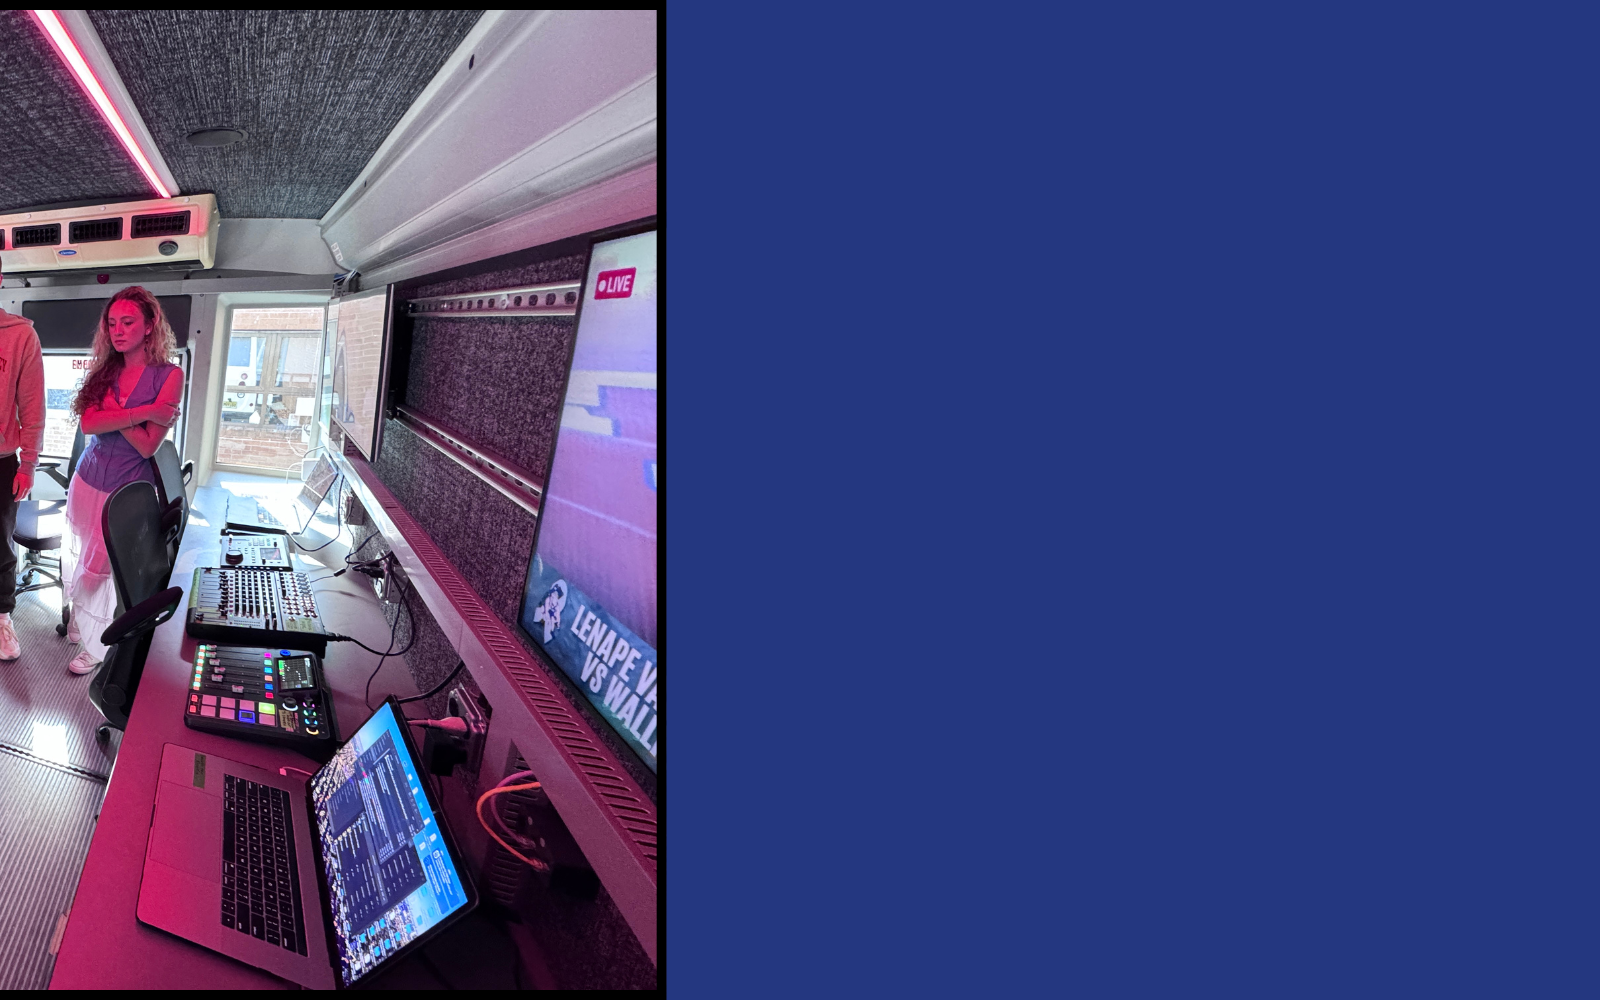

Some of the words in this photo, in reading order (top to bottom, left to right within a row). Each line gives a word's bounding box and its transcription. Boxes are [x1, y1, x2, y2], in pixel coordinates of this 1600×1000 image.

[606, 274, 632, 293] LIVE
[570, 604, 642, 683] LENAPE
[580, 651, 609, 694] VS
[602, 674, 658, 758] WALL
